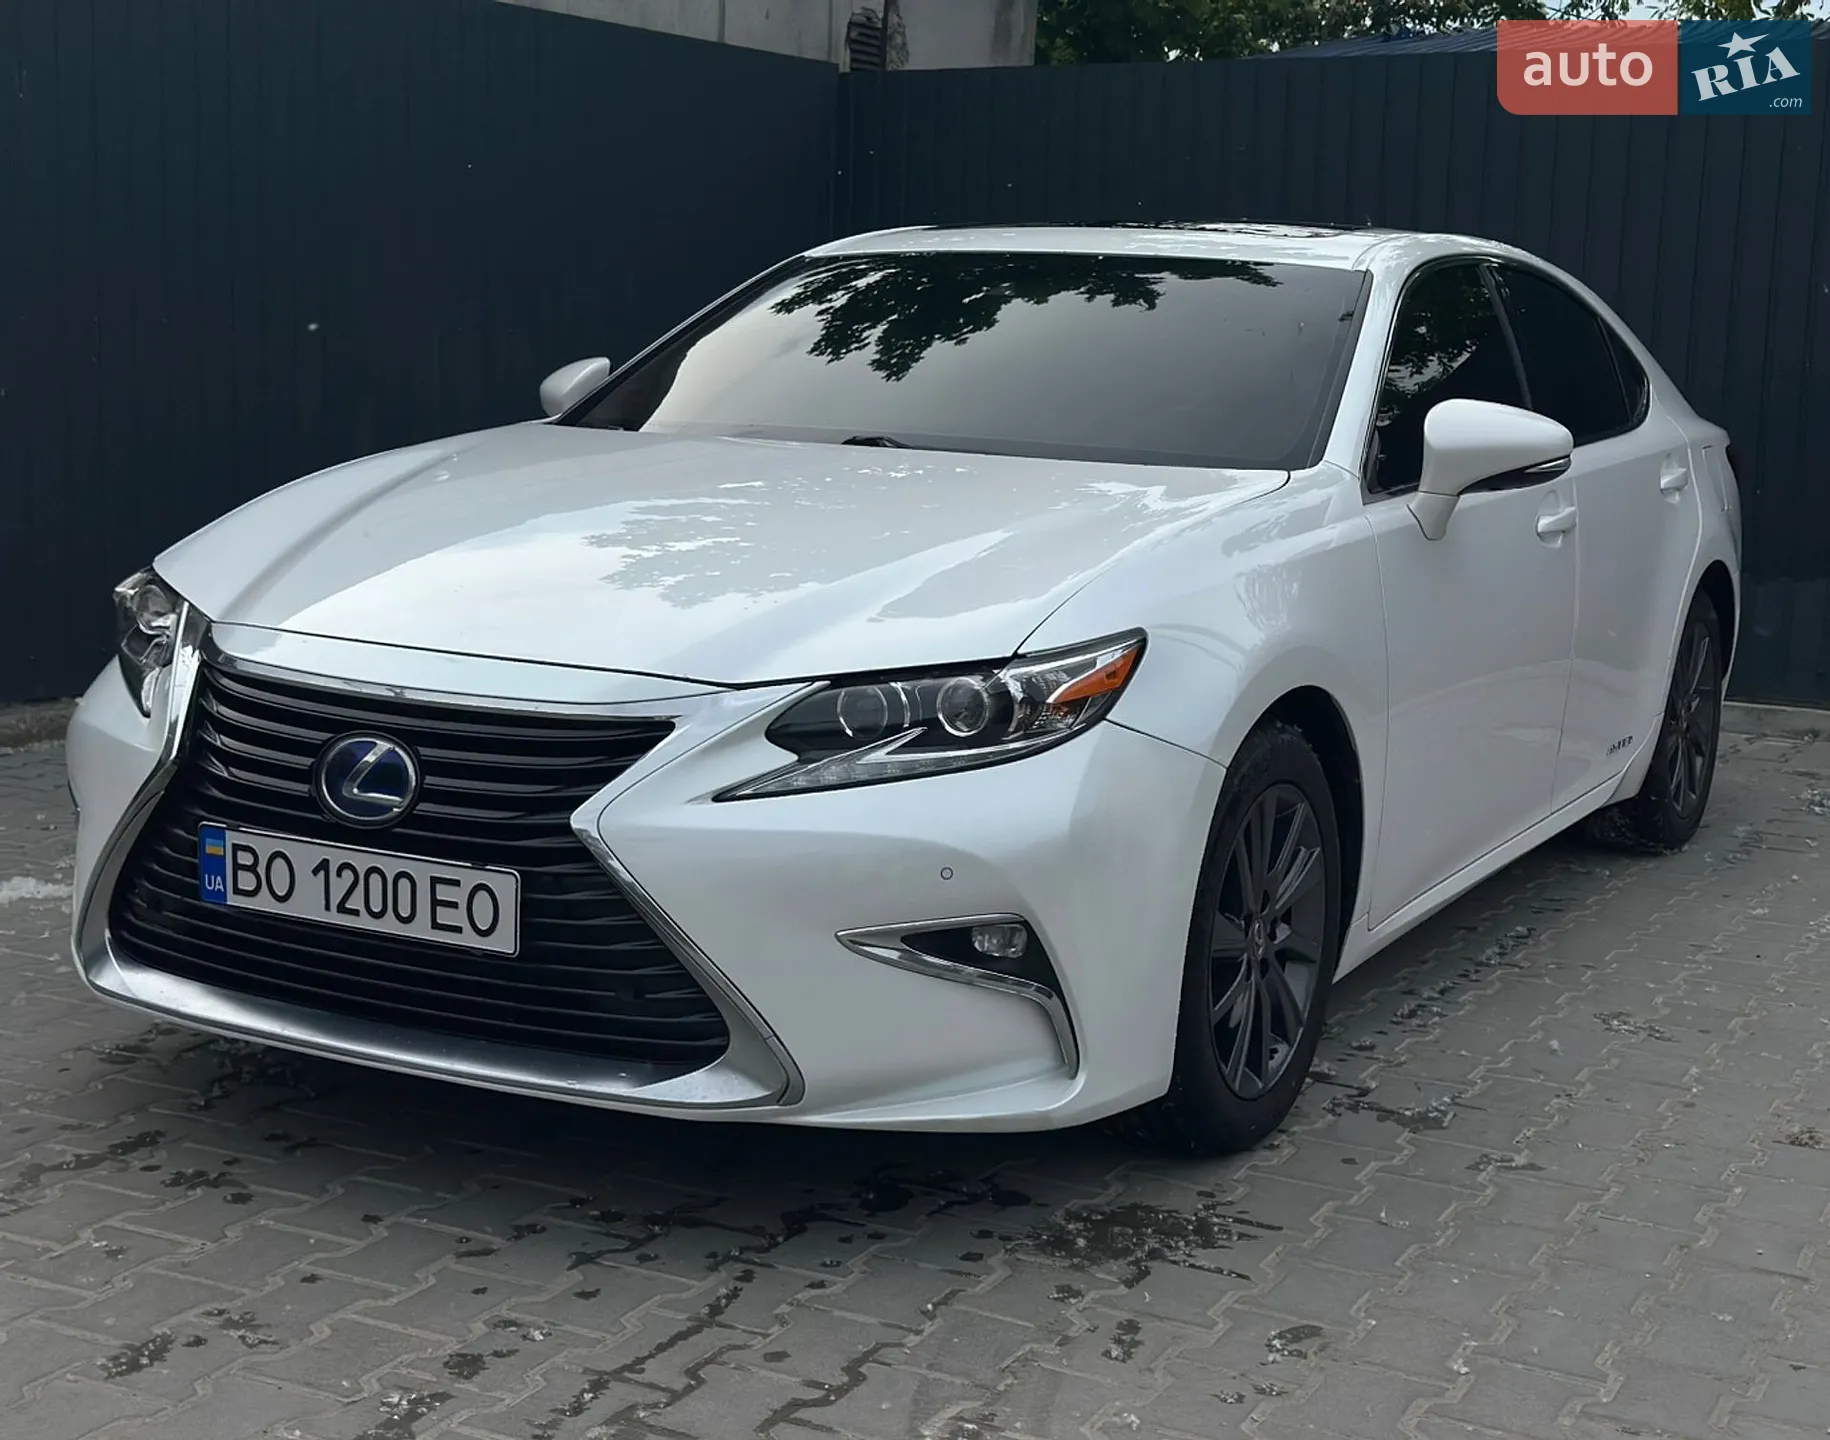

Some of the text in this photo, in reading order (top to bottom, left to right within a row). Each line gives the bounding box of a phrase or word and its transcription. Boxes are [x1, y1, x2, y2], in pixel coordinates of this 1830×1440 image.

[204, 874, 225, 893] UA
[230, 842, 500, 938] BO 1200 EO
